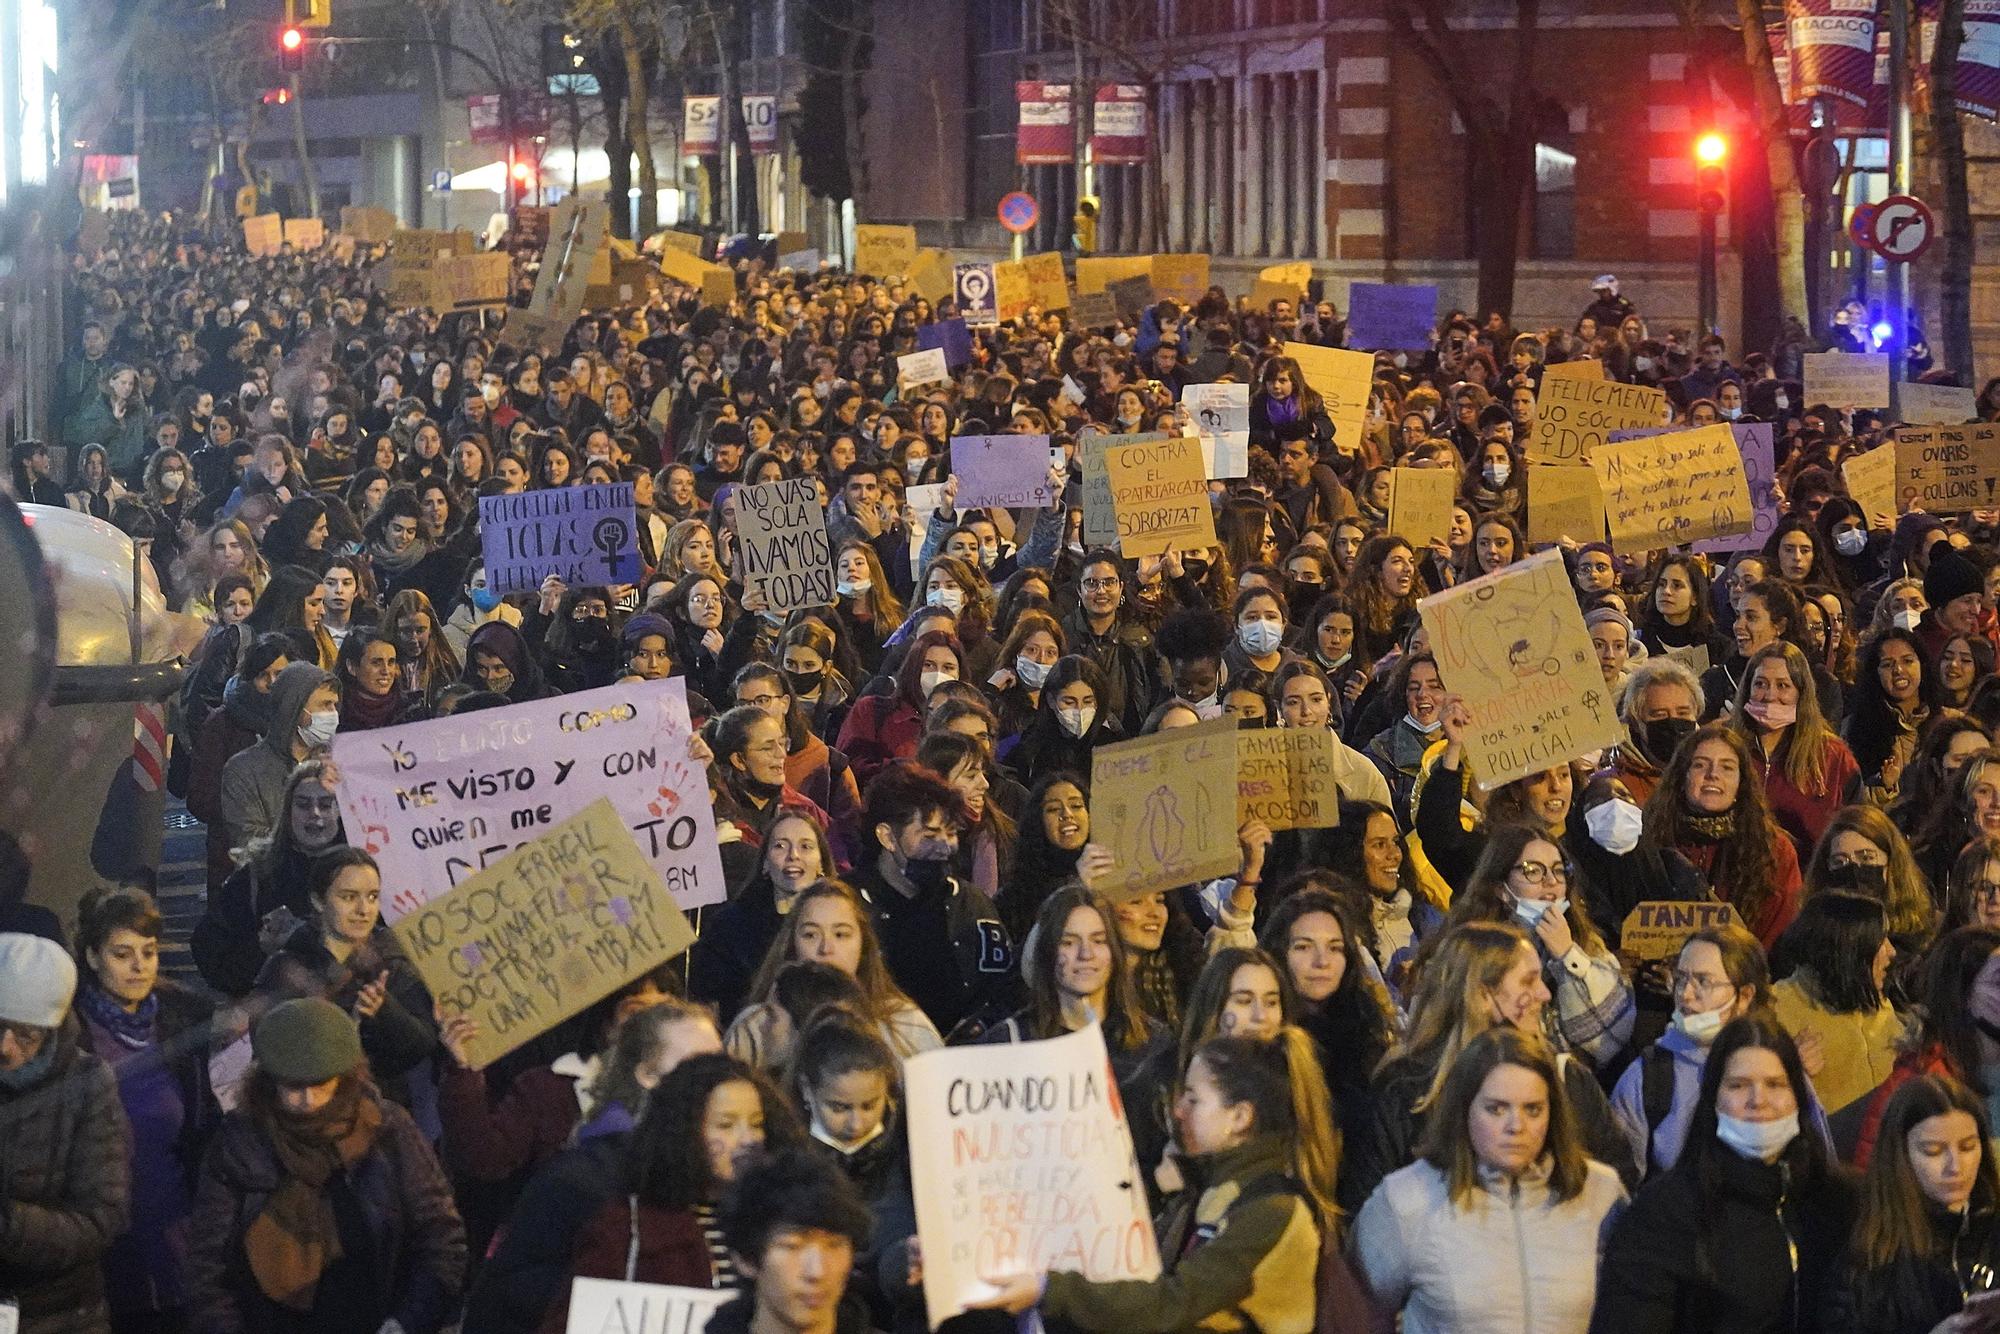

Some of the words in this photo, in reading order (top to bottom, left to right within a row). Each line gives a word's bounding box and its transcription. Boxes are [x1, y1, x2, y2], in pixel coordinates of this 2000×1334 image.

[1539, 405, 1567, 422] JO
[1121, 443, 1188, 468] CONTRA
[1923, 444, 1969, 462] OVARIS
[1147, 469, 1164, 481] EL
[740, 485, 769, 511] NO
[775, 479, 816, 505] VAS
[757, 504, 809, 531] SOLA
[1482, 727, 1506, 746] POR
[603, 746, 657, 778] CON
[666, 865, 699, 892] 8M
[1637, 904, 1732, 930] TANTO
[977, 919, 1013, 972] B
[948, 1077, 1058, 1117] CUANDO
[1068, 1071, 1099, 1113] LA
